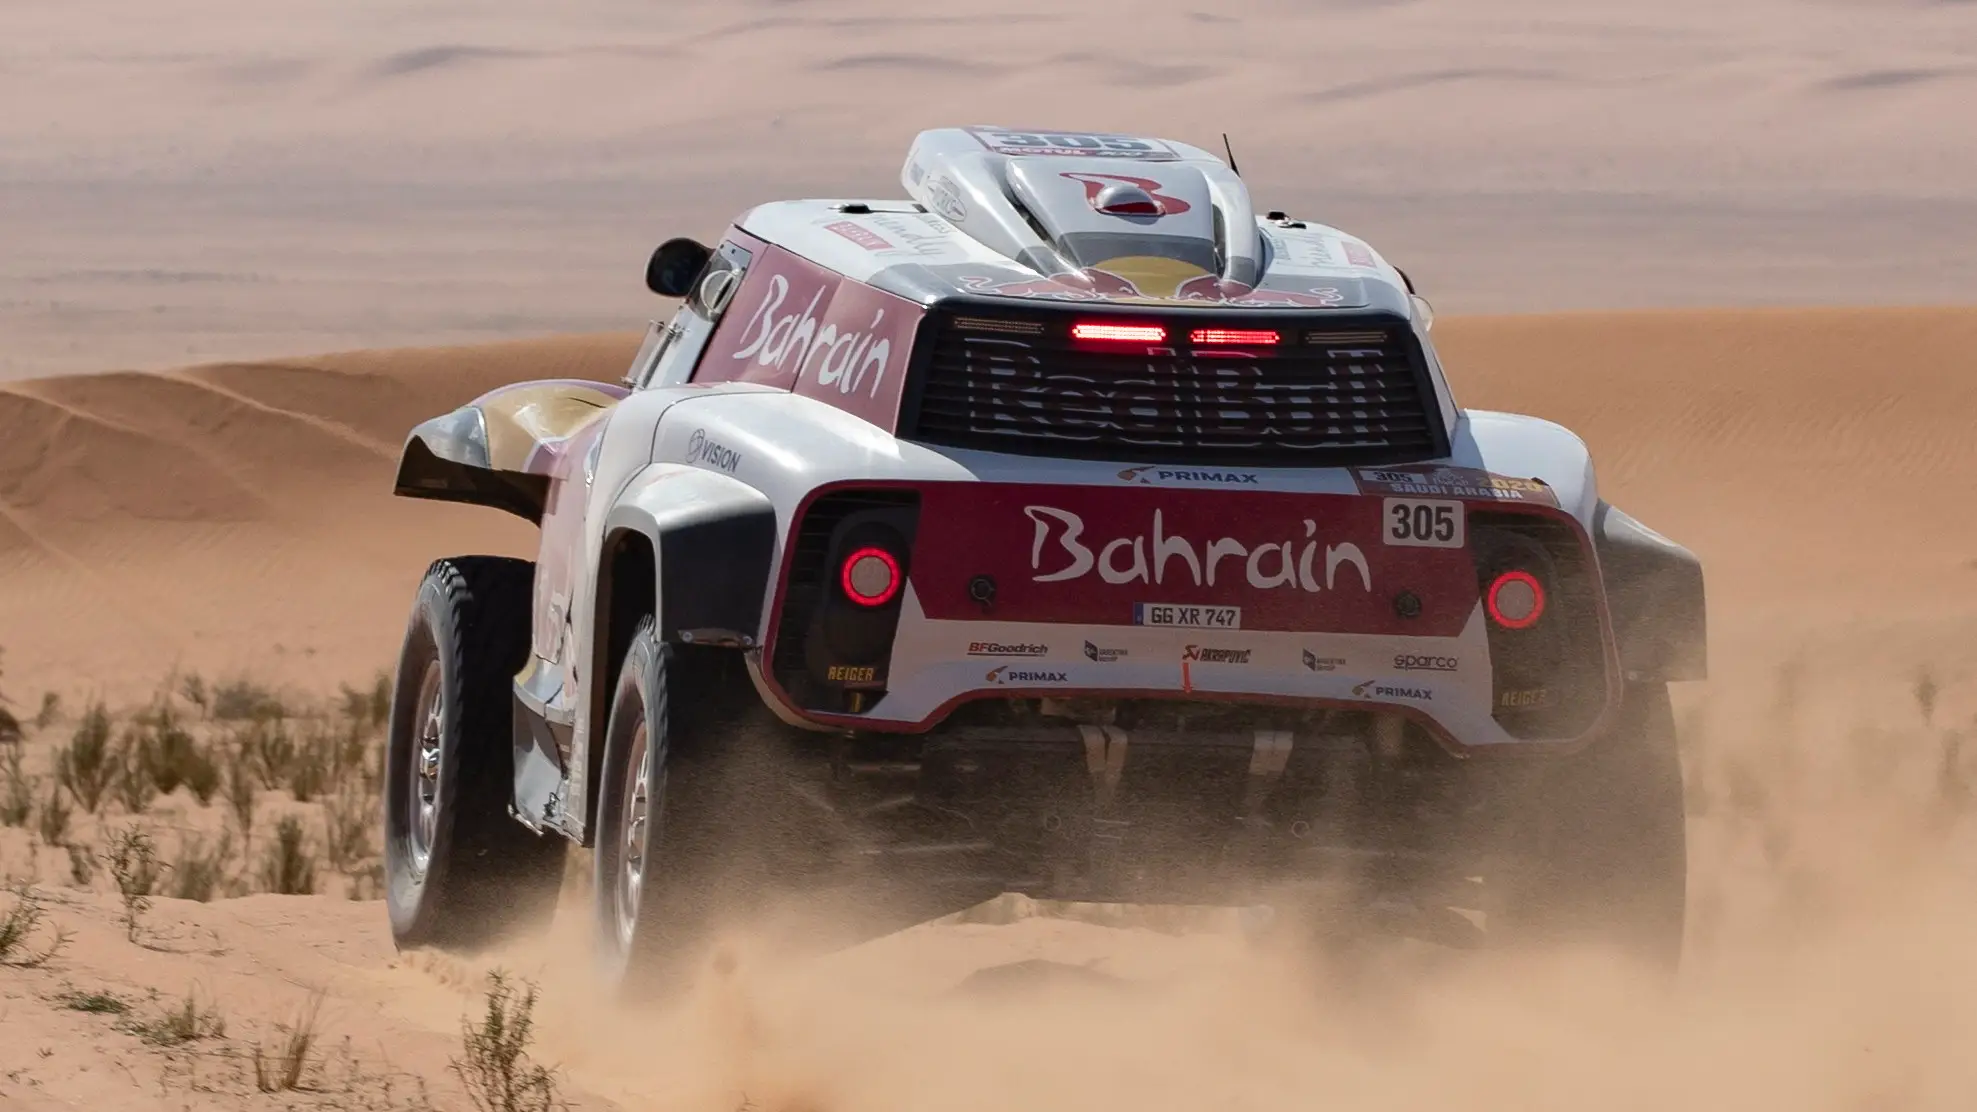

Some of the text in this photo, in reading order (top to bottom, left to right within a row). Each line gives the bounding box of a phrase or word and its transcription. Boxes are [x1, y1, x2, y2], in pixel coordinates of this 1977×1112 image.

[993, 133, 1152, 151] 305
[732, 274, 890, 399] Bahrain
[701, 439, 741, 474] VISION
[1159, 471, 1258, 484] PRIMAX
[1375, 471, 1413, 483] 305
[1391, 483, 1523, 499] SAUDI ARABIA
[1391, 504, 1454, 542] 305
[1024, 505, 1372, 593] Bahrain
[1151, 606, 1236, 627] GG XR 747
[968, 642, 1048, 655] BFGoodrich
[1394, 654, 1457, 670] sparco
[828, 666, 873, 682] REIGER
[1009, 671, 1067, 683] PRIMAX
[1376, 686, 1432, 700] PRIMAX
